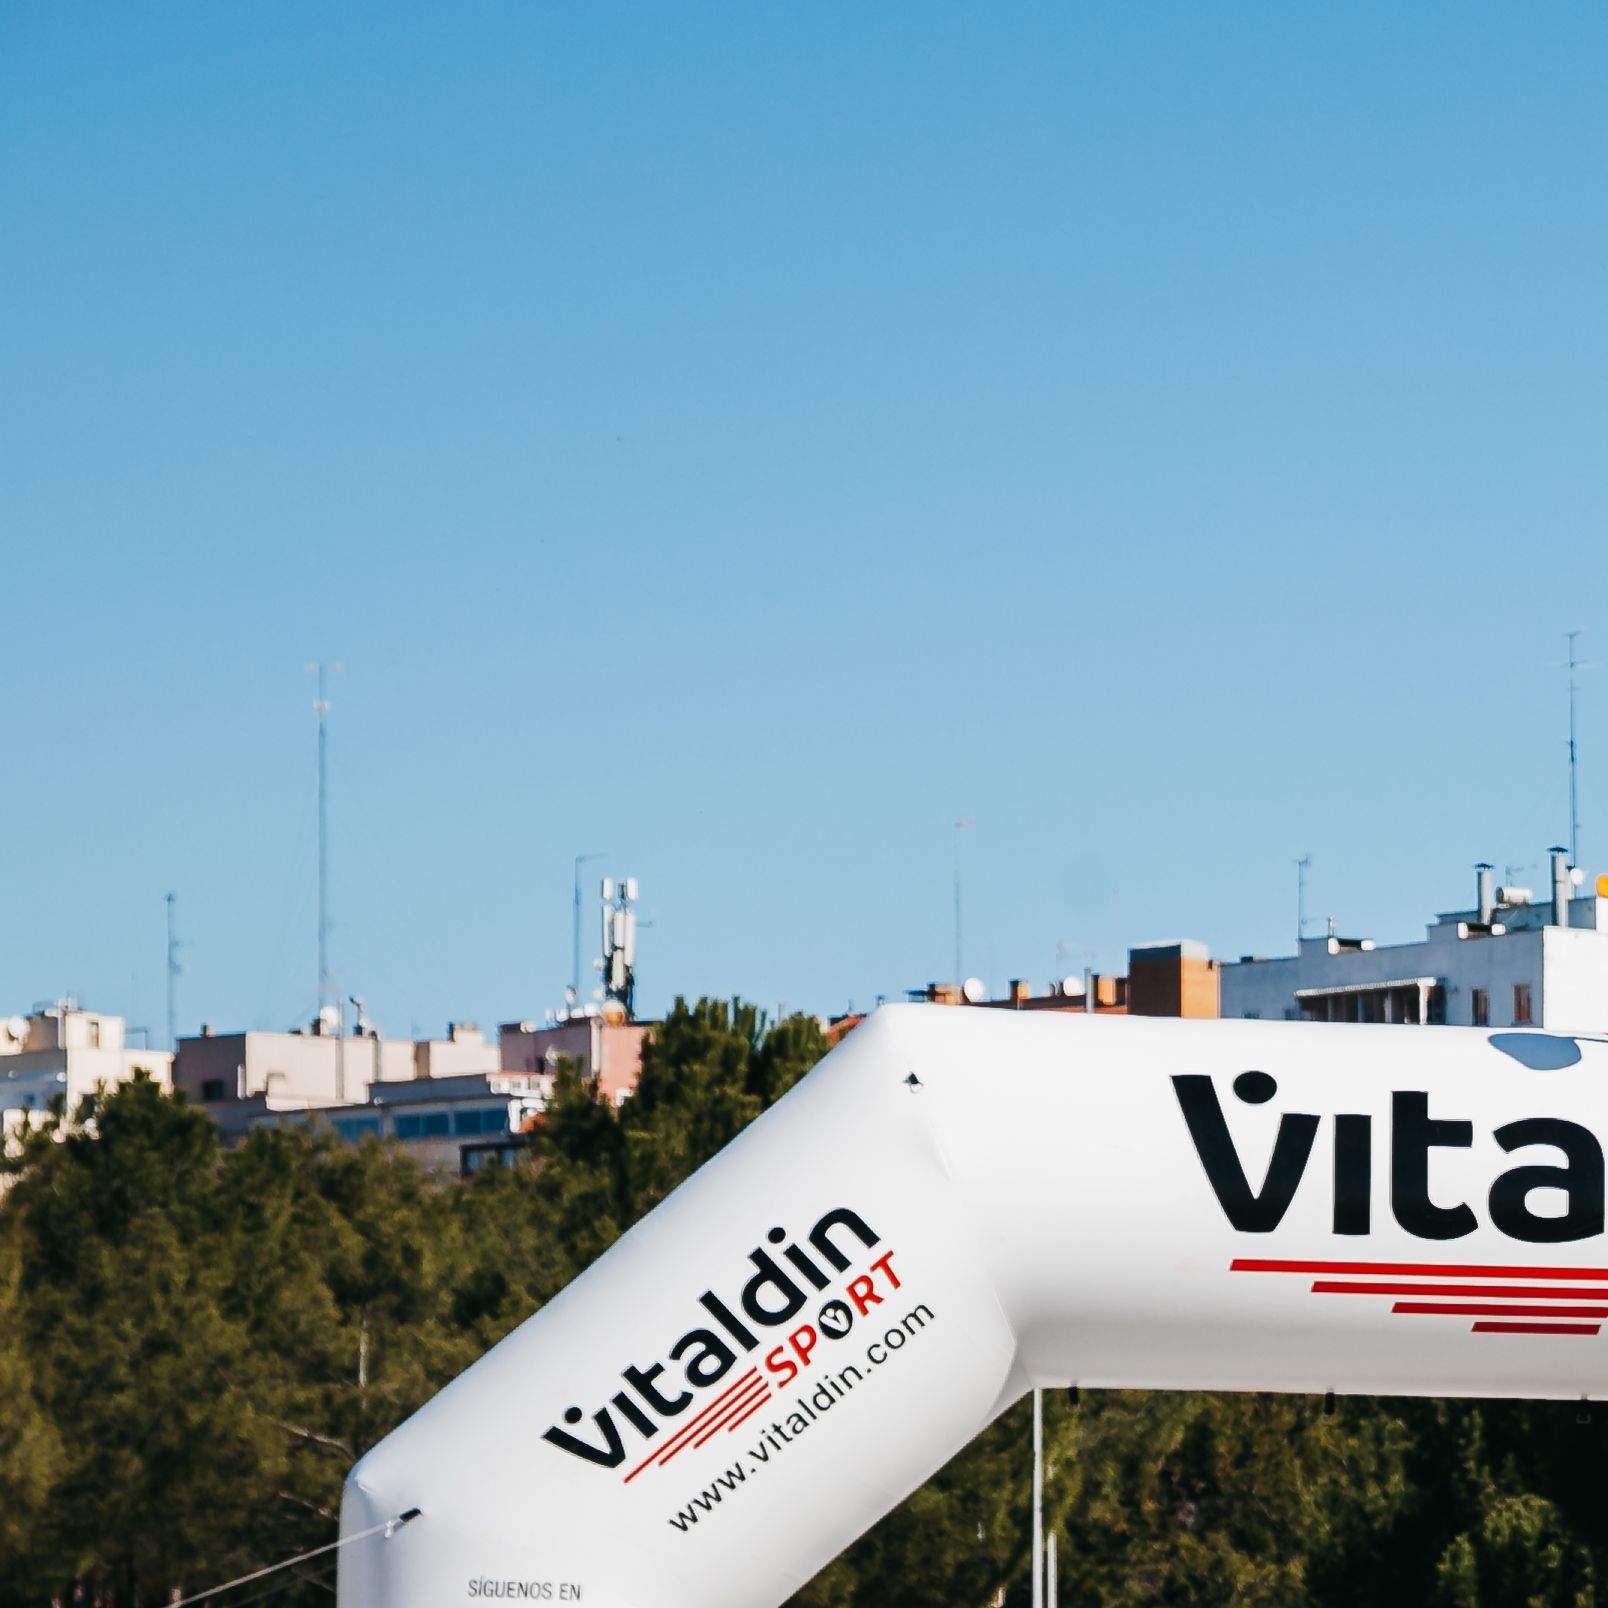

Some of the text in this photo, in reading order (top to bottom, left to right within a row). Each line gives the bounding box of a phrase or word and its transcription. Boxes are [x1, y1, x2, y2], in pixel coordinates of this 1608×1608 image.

[540, 1206, 882, 1470] Vitaldin
[764, 1250, 904, 1391] SPORT
[668, 1300, 936, 1534] www.vitaldin.com
[467, 1575, 582, 1601] SÍGUENOS EN
